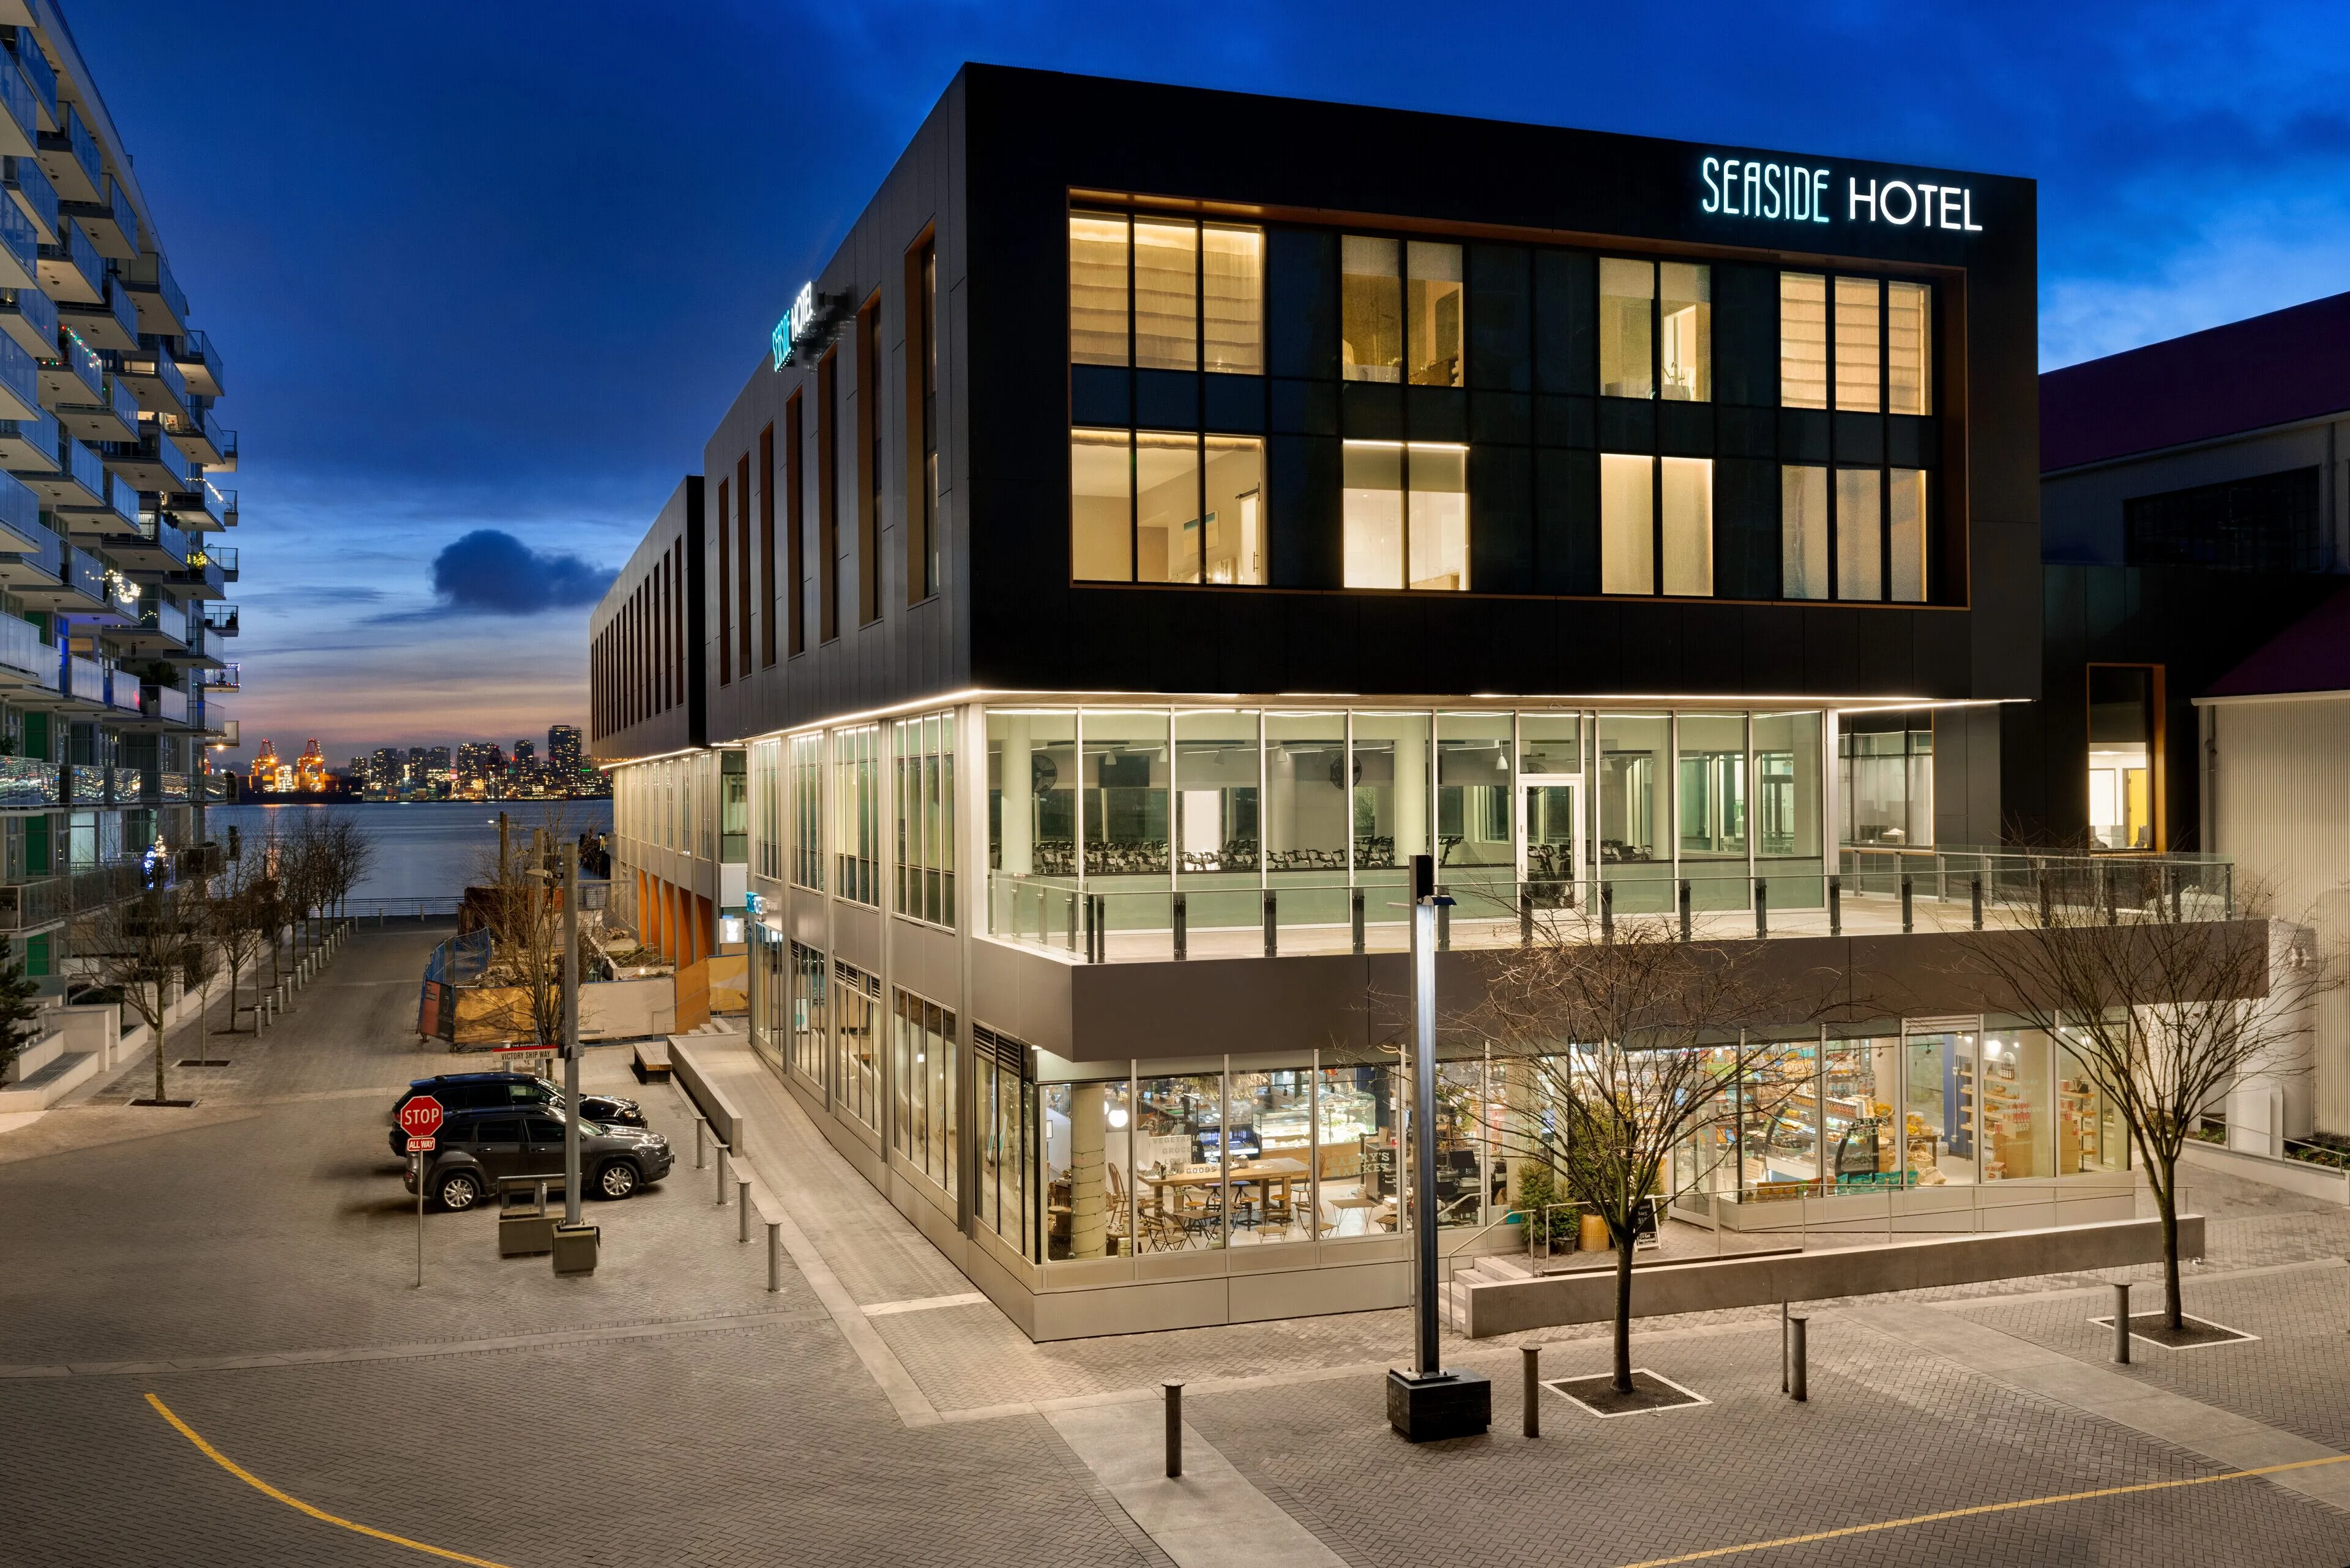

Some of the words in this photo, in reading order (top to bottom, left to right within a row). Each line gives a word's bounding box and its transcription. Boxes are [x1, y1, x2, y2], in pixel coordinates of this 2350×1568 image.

[1702, 157, 1830, 223] SEASIDE
[1849, 177, 1983, 231] HOTEL
[791, 281, 813, 342] HOTEL
[405, 1108, 439, 1125] STOP
[1186, 1166, 1217, 1174] GOODS
